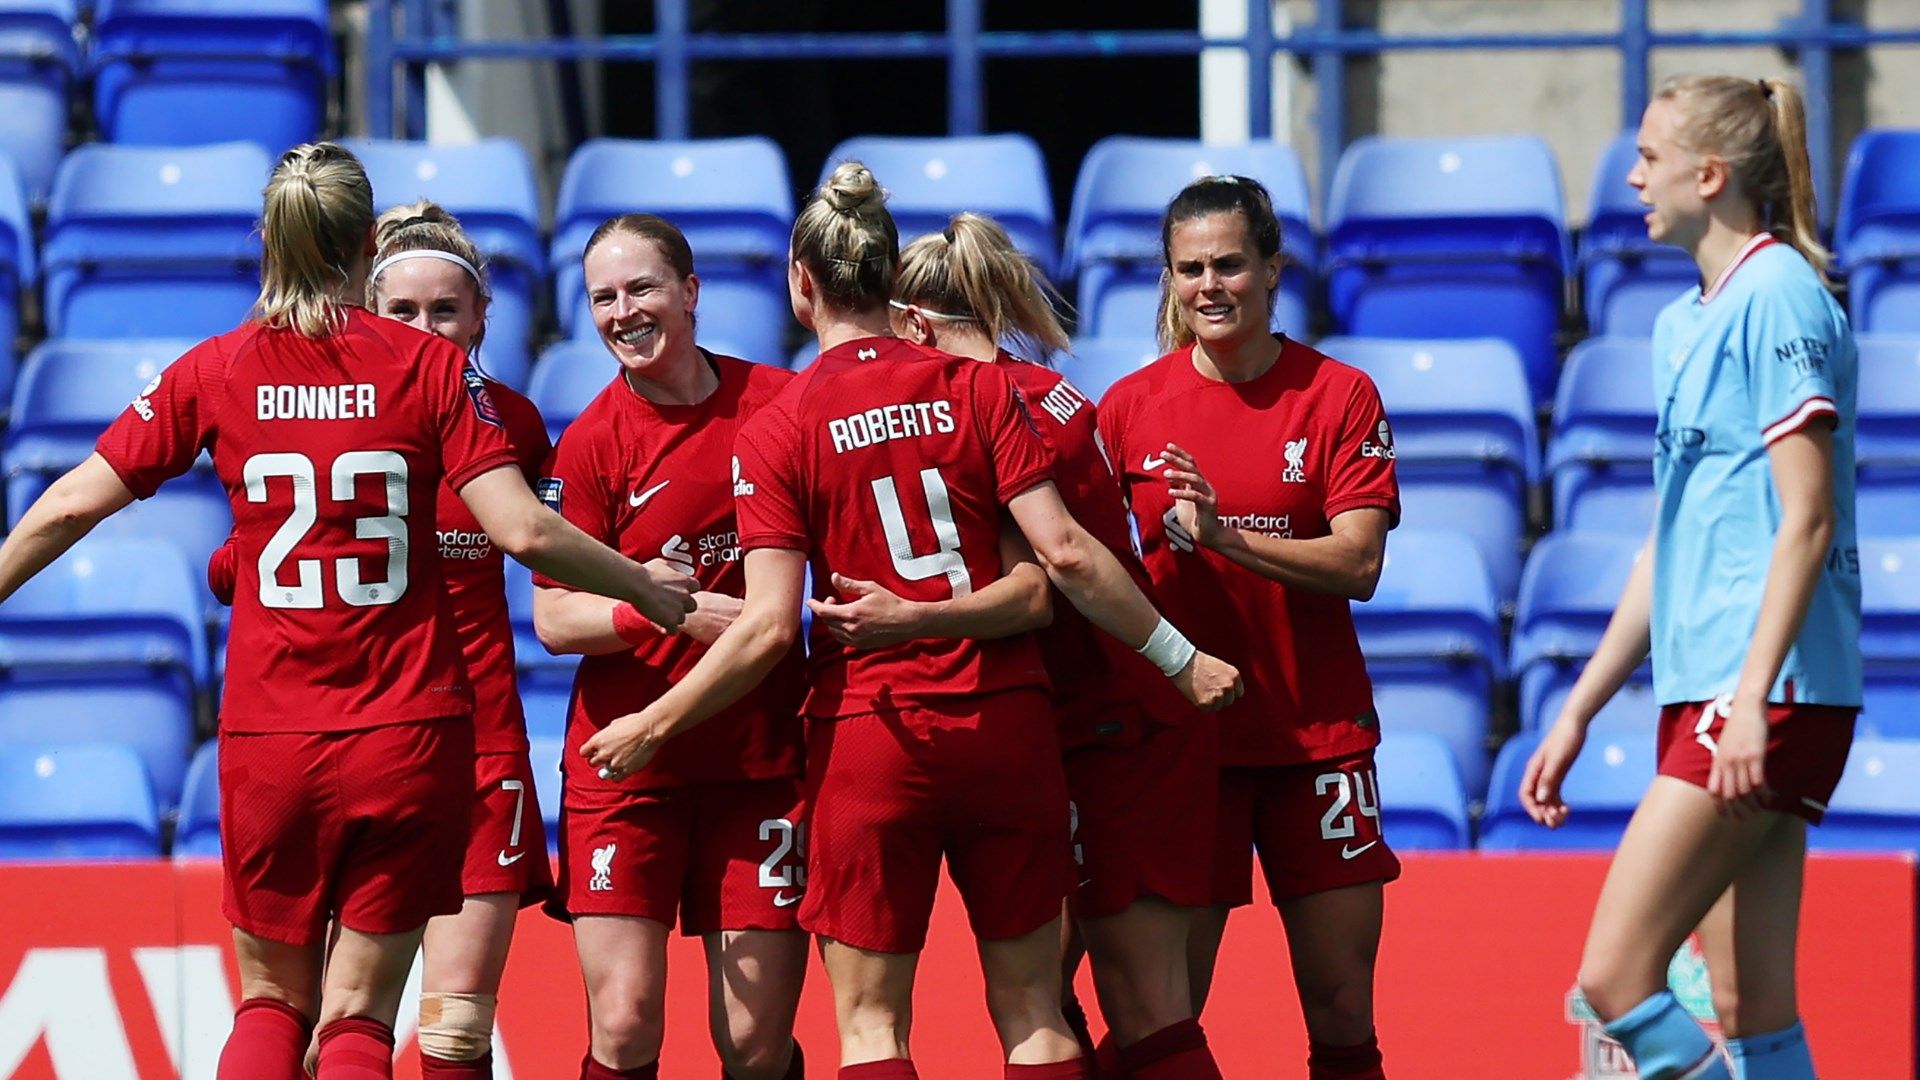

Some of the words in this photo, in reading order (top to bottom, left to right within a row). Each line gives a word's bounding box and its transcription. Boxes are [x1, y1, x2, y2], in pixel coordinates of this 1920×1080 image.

[256, 384, 376, 421] BONNER
[828, 400, 955, 454] ROBERTS
[242, 450, 409, 609] 23
[871, 467, 972, 599] 4
[502, 780, 524, 847] 7
[1315, 769, 1381, 840] 24
[758, 818, 806, 888] 2
